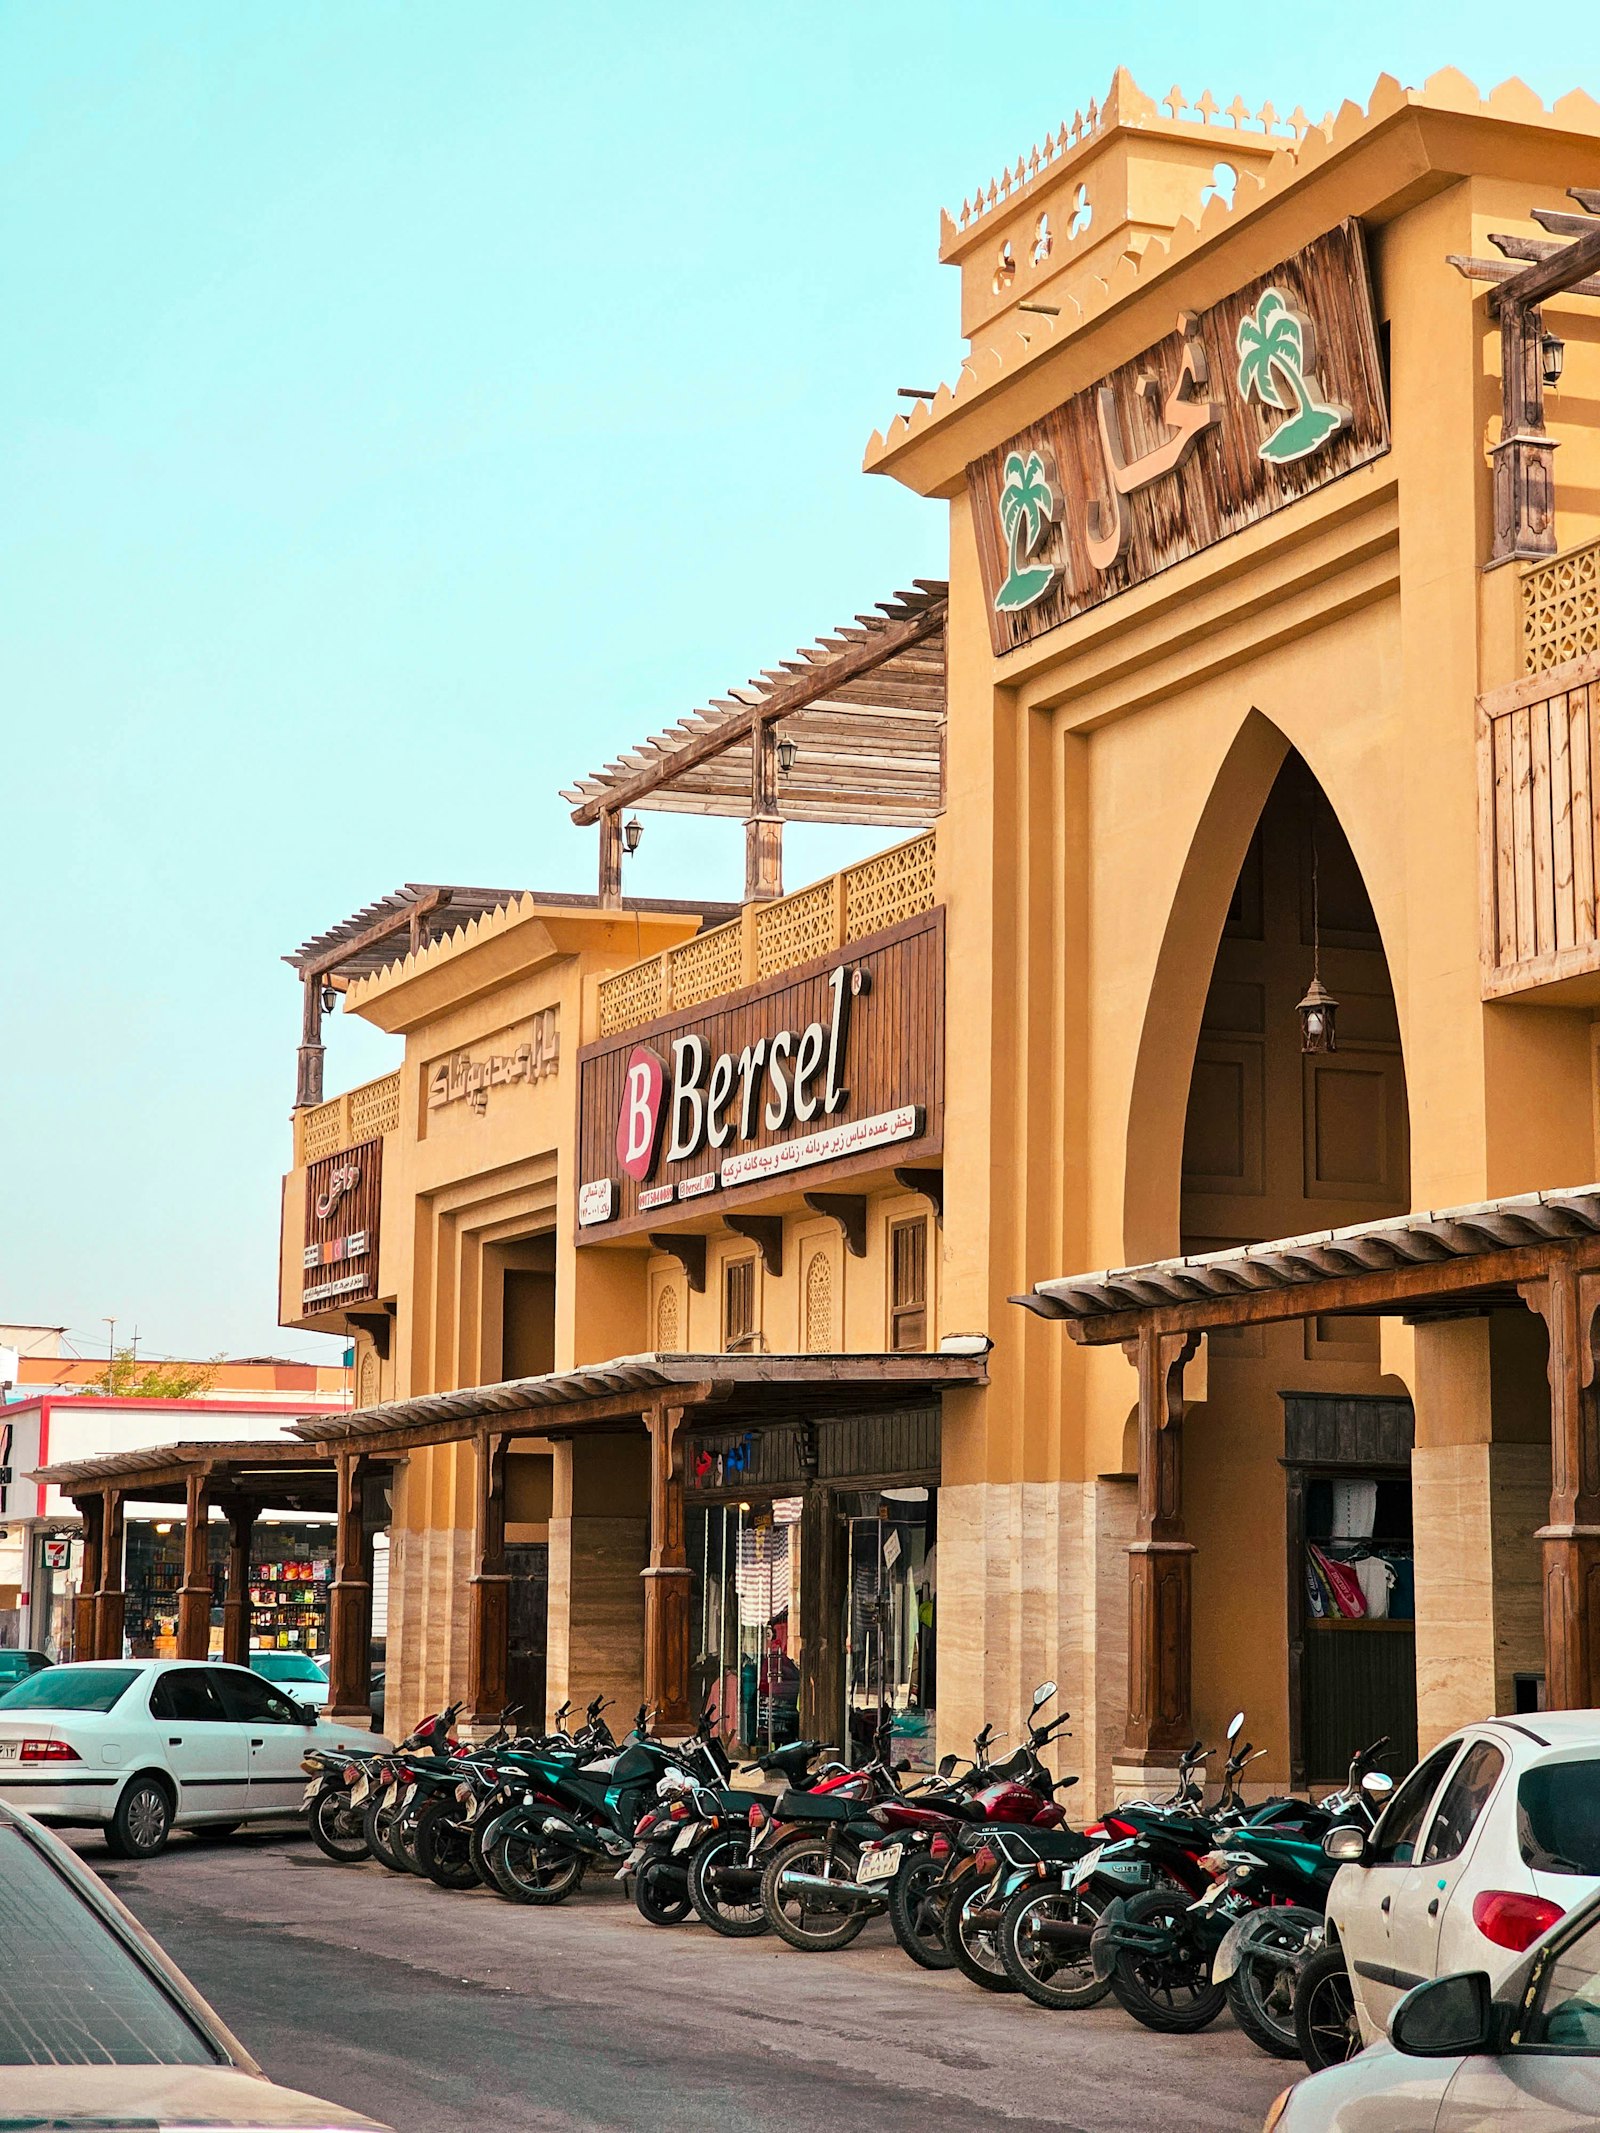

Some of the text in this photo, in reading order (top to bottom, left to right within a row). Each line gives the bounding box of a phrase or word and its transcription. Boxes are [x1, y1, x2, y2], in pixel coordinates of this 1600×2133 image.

[667, 965, 847, 1163] Bersel
[869, 1121, 888, 1137] عمده
[891, 1113, 913, 1135] پخش
[831, 1133, 844, 1153] زیر
[846, 1124, 867, 1147] لباس
[781, 1145, 800, 1163] زنانه
[723, 1161, 742, 1182] ترکیه
